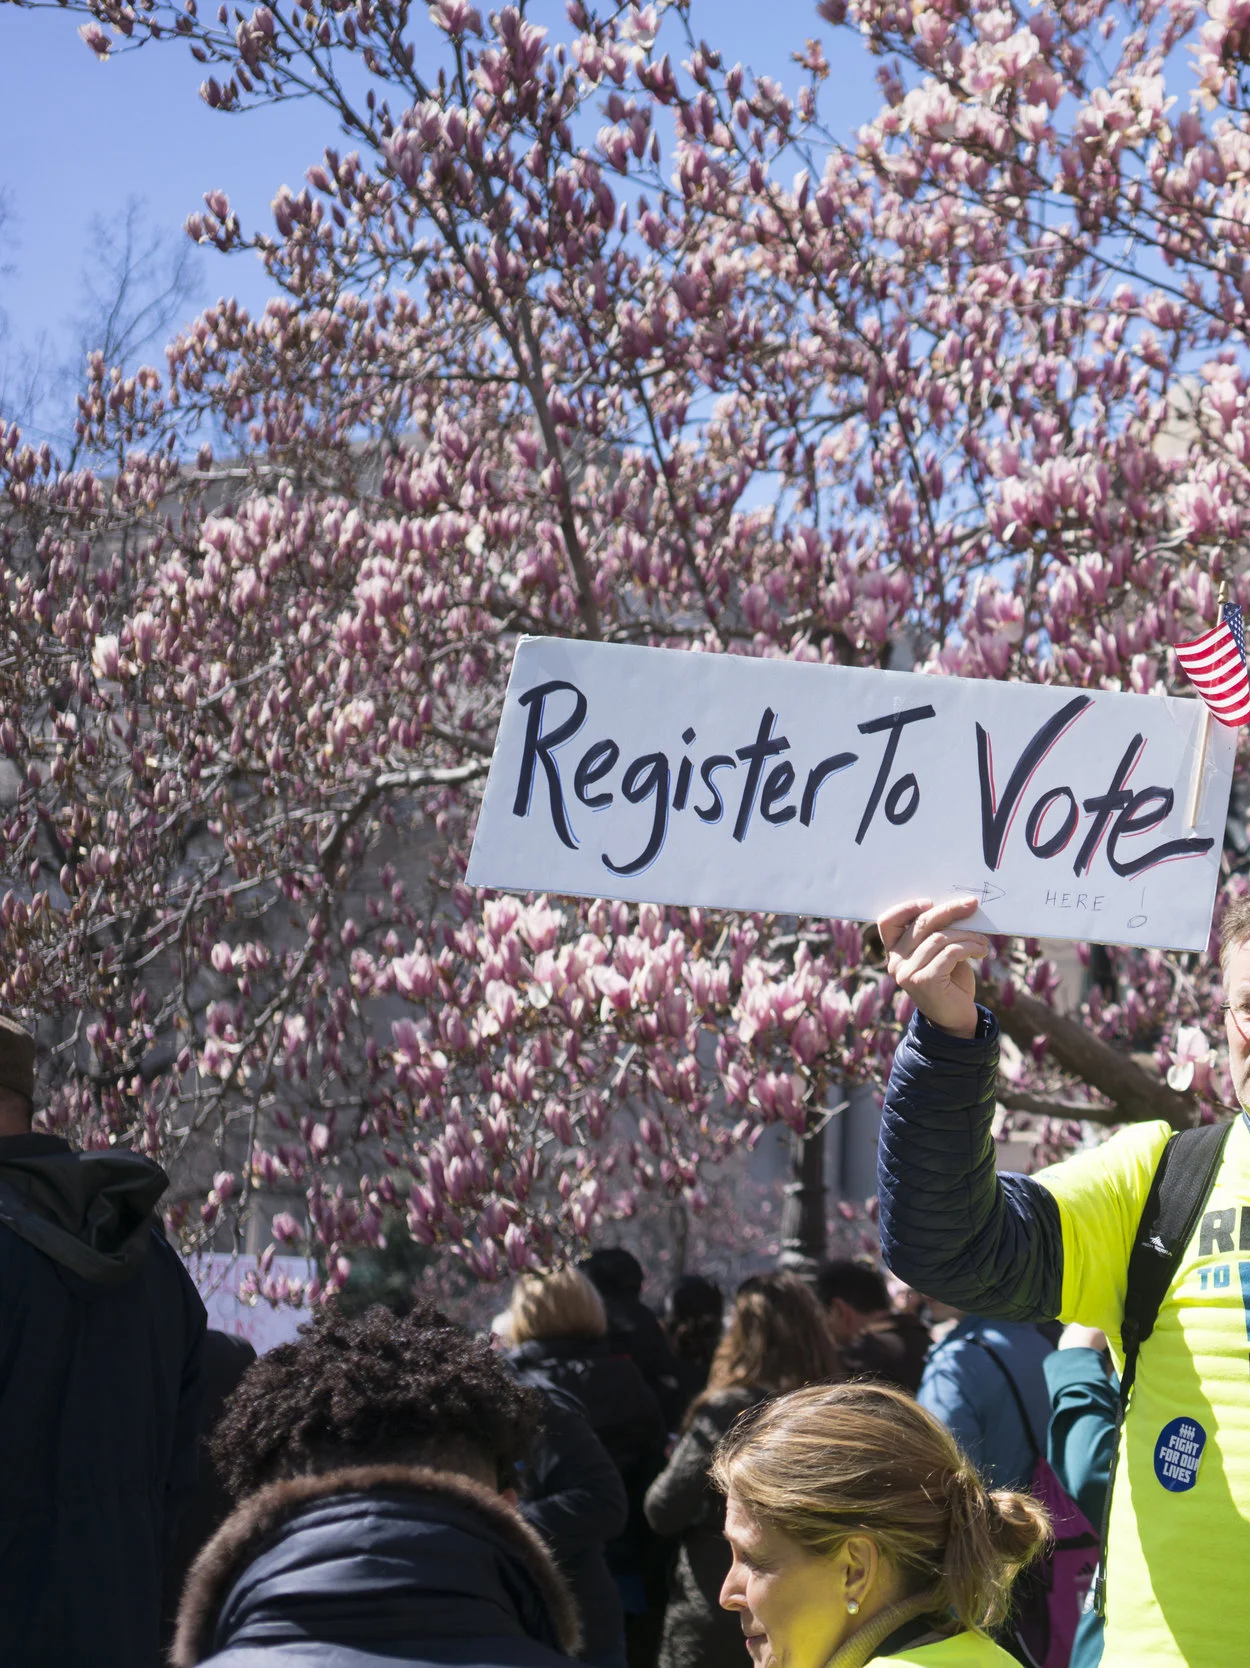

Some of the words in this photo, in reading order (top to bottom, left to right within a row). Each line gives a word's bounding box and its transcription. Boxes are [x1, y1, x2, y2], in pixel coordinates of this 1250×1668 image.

[513, 680, 859, 877] Register
[855, 704, 936, 845] To
[975, 694, 1215, 881] Vote
[1045, 889, 1106, 912] HERE
[1197, 1264, 1231, 1291] TO
[1159, 1446, 1180, 1464] FOR
[1168, 1435, 1199, 1455] FIGHT
[1162, 1462, 1191, 1483] LIVES
